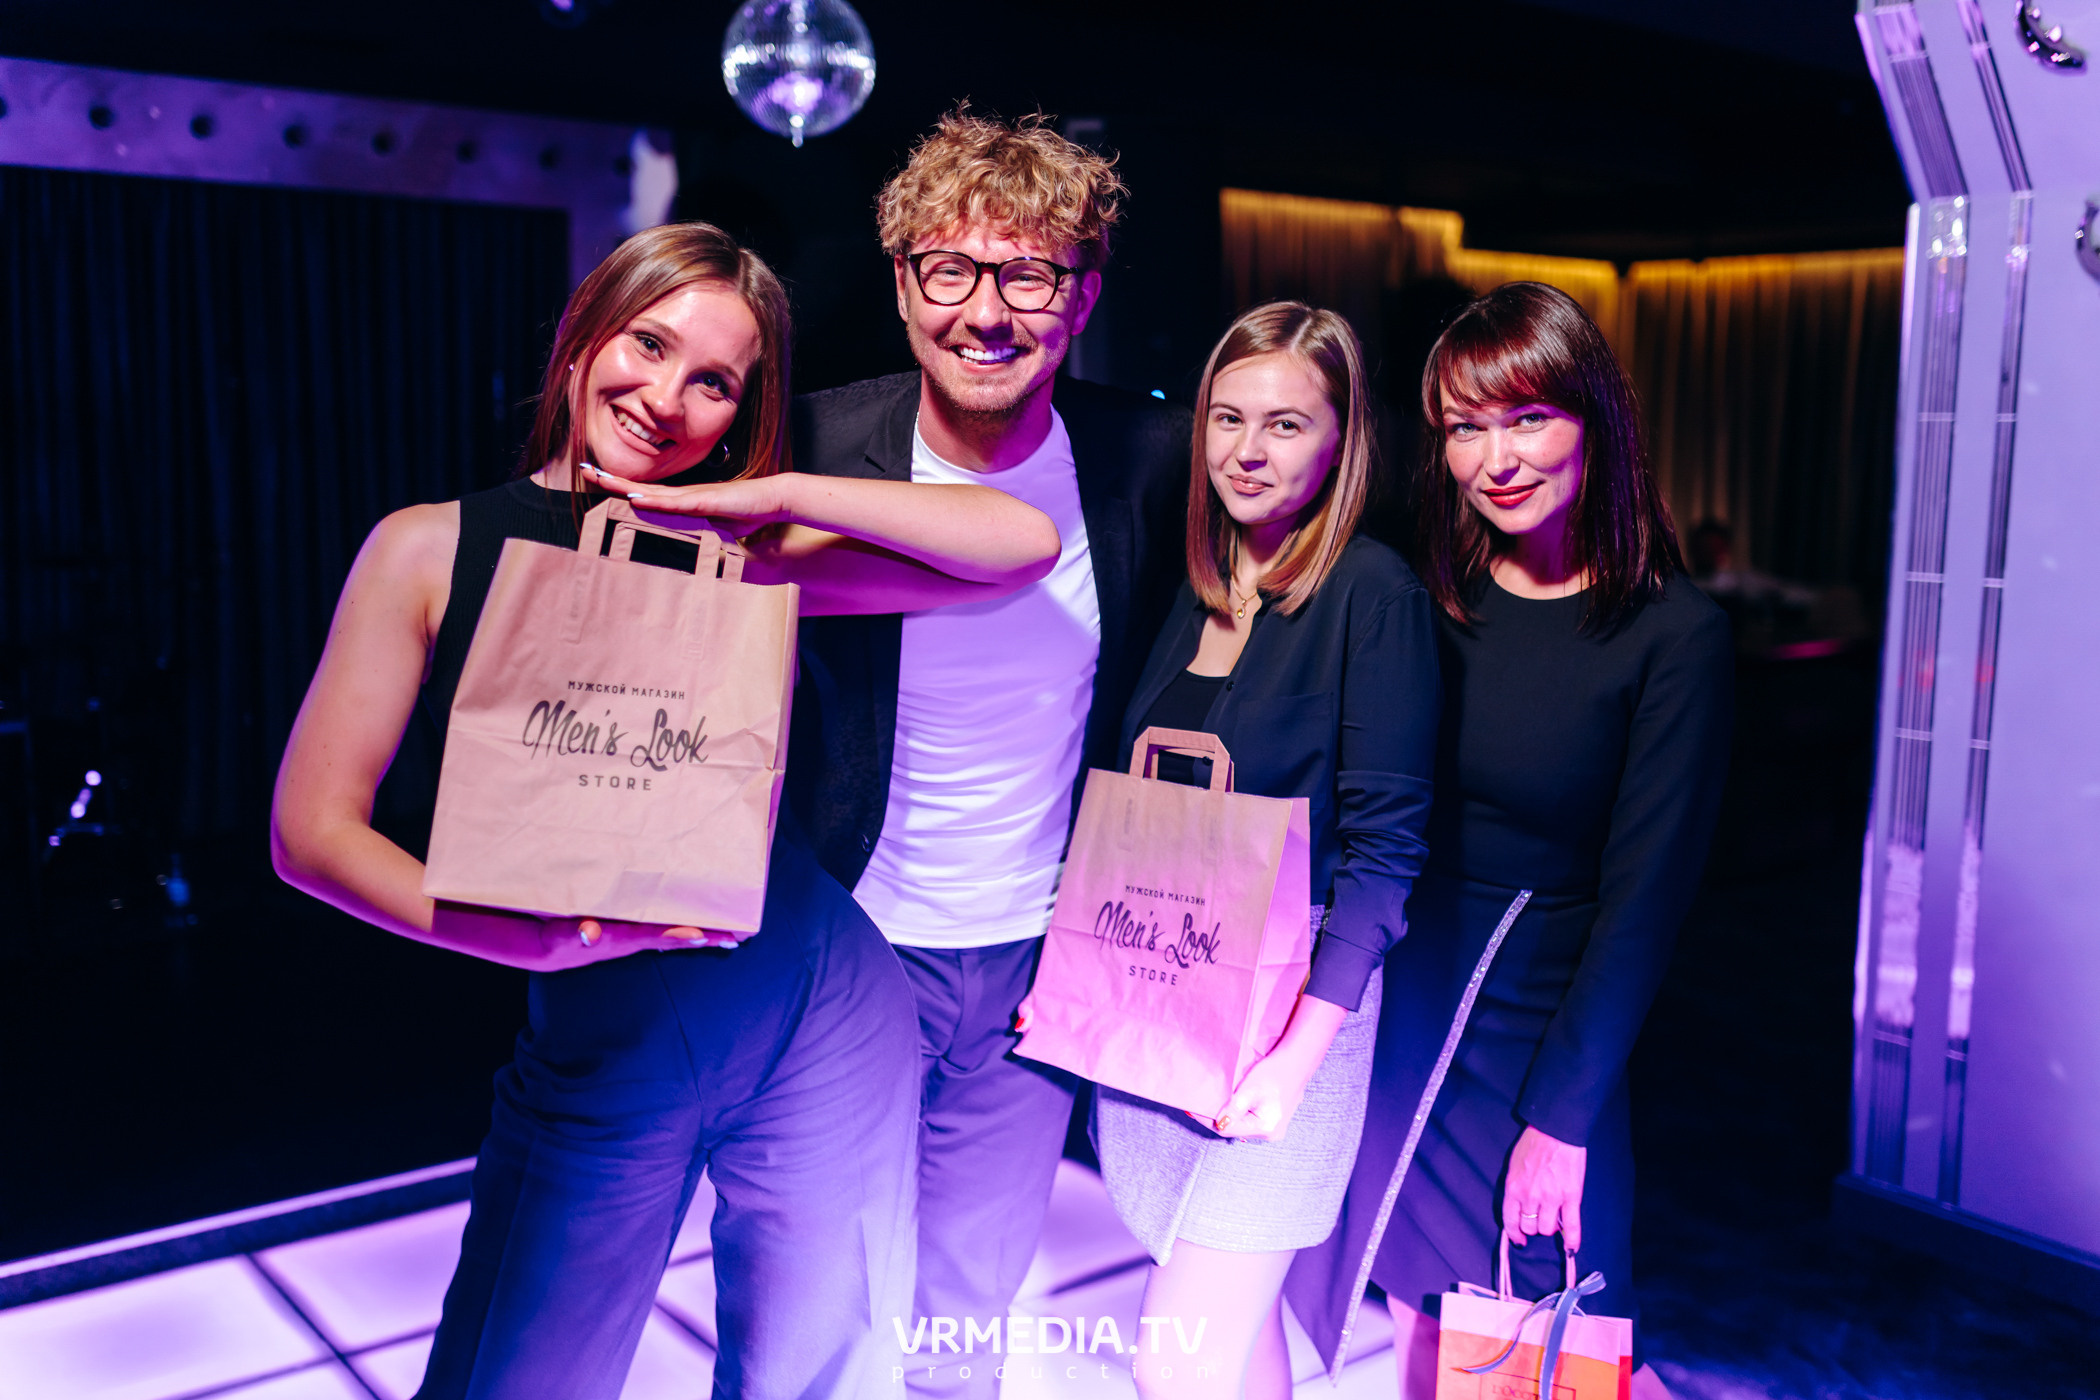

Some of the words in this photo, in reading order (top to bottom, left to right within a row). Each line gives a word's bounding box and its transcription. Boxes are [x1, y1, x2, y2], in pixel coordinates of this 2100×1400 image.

[567, 680, 626, 695] МУЖСКОЙ
[631, 687, 686, 700] МАГАЗИН
[522, 699, 629, 760] Men's
[630, 708, 709, 772] Look
[578, 774, 652, 791] STORE
[1125, 885, 1165, 899] МУЖСКОЙ
[1168, 892, 1206, 906] МАГАЗИН
[1094, 900, 1166, 951] Men's
[1164, 912, 1221, 969] Look
[1128, 965, 1178, 986] STORE
